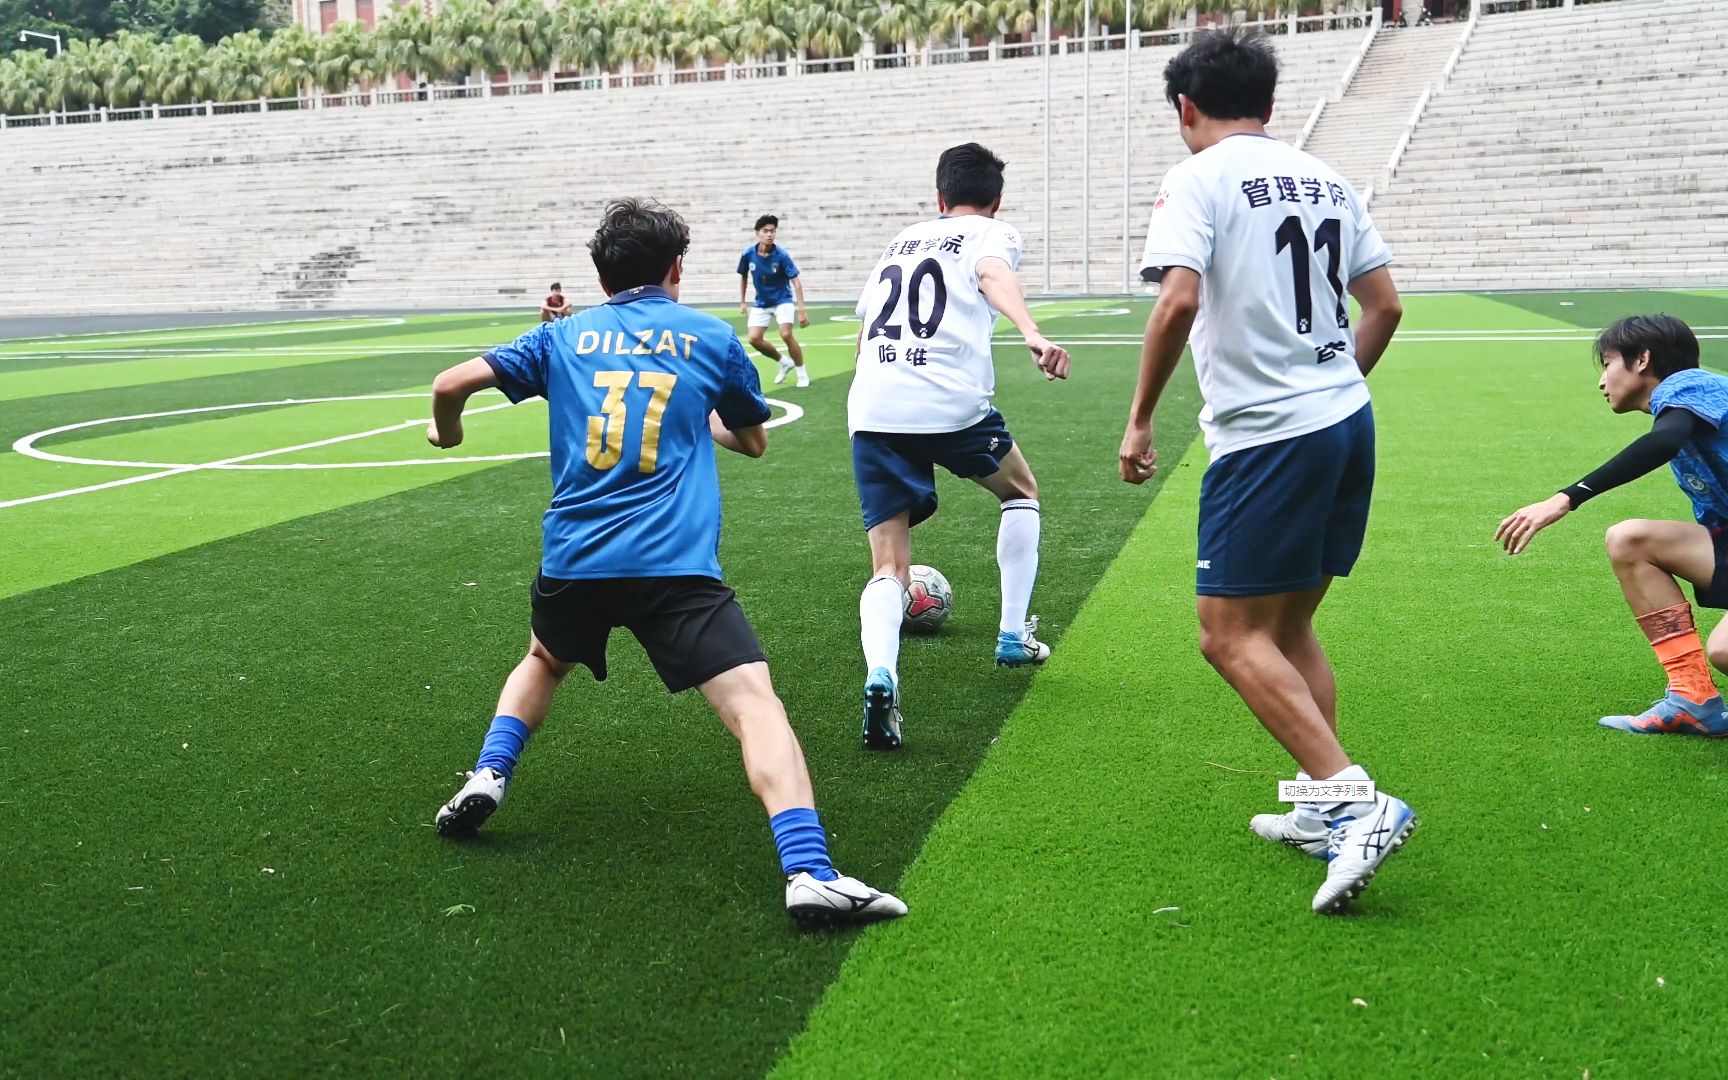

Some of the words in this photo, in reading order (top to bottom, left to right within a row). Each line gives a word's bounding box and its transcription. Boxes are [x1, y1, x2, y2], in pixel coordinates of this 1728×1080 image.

[1240, 175, 1349, 210] 管理学院
[867, 257, 947, 341] 20
[1274, 215, 1349, 335] 11
[575, 328, 698, 361] DILZAT
[878, 344, 928, 367] 哈维
[585, 370, 678, 474] 37
